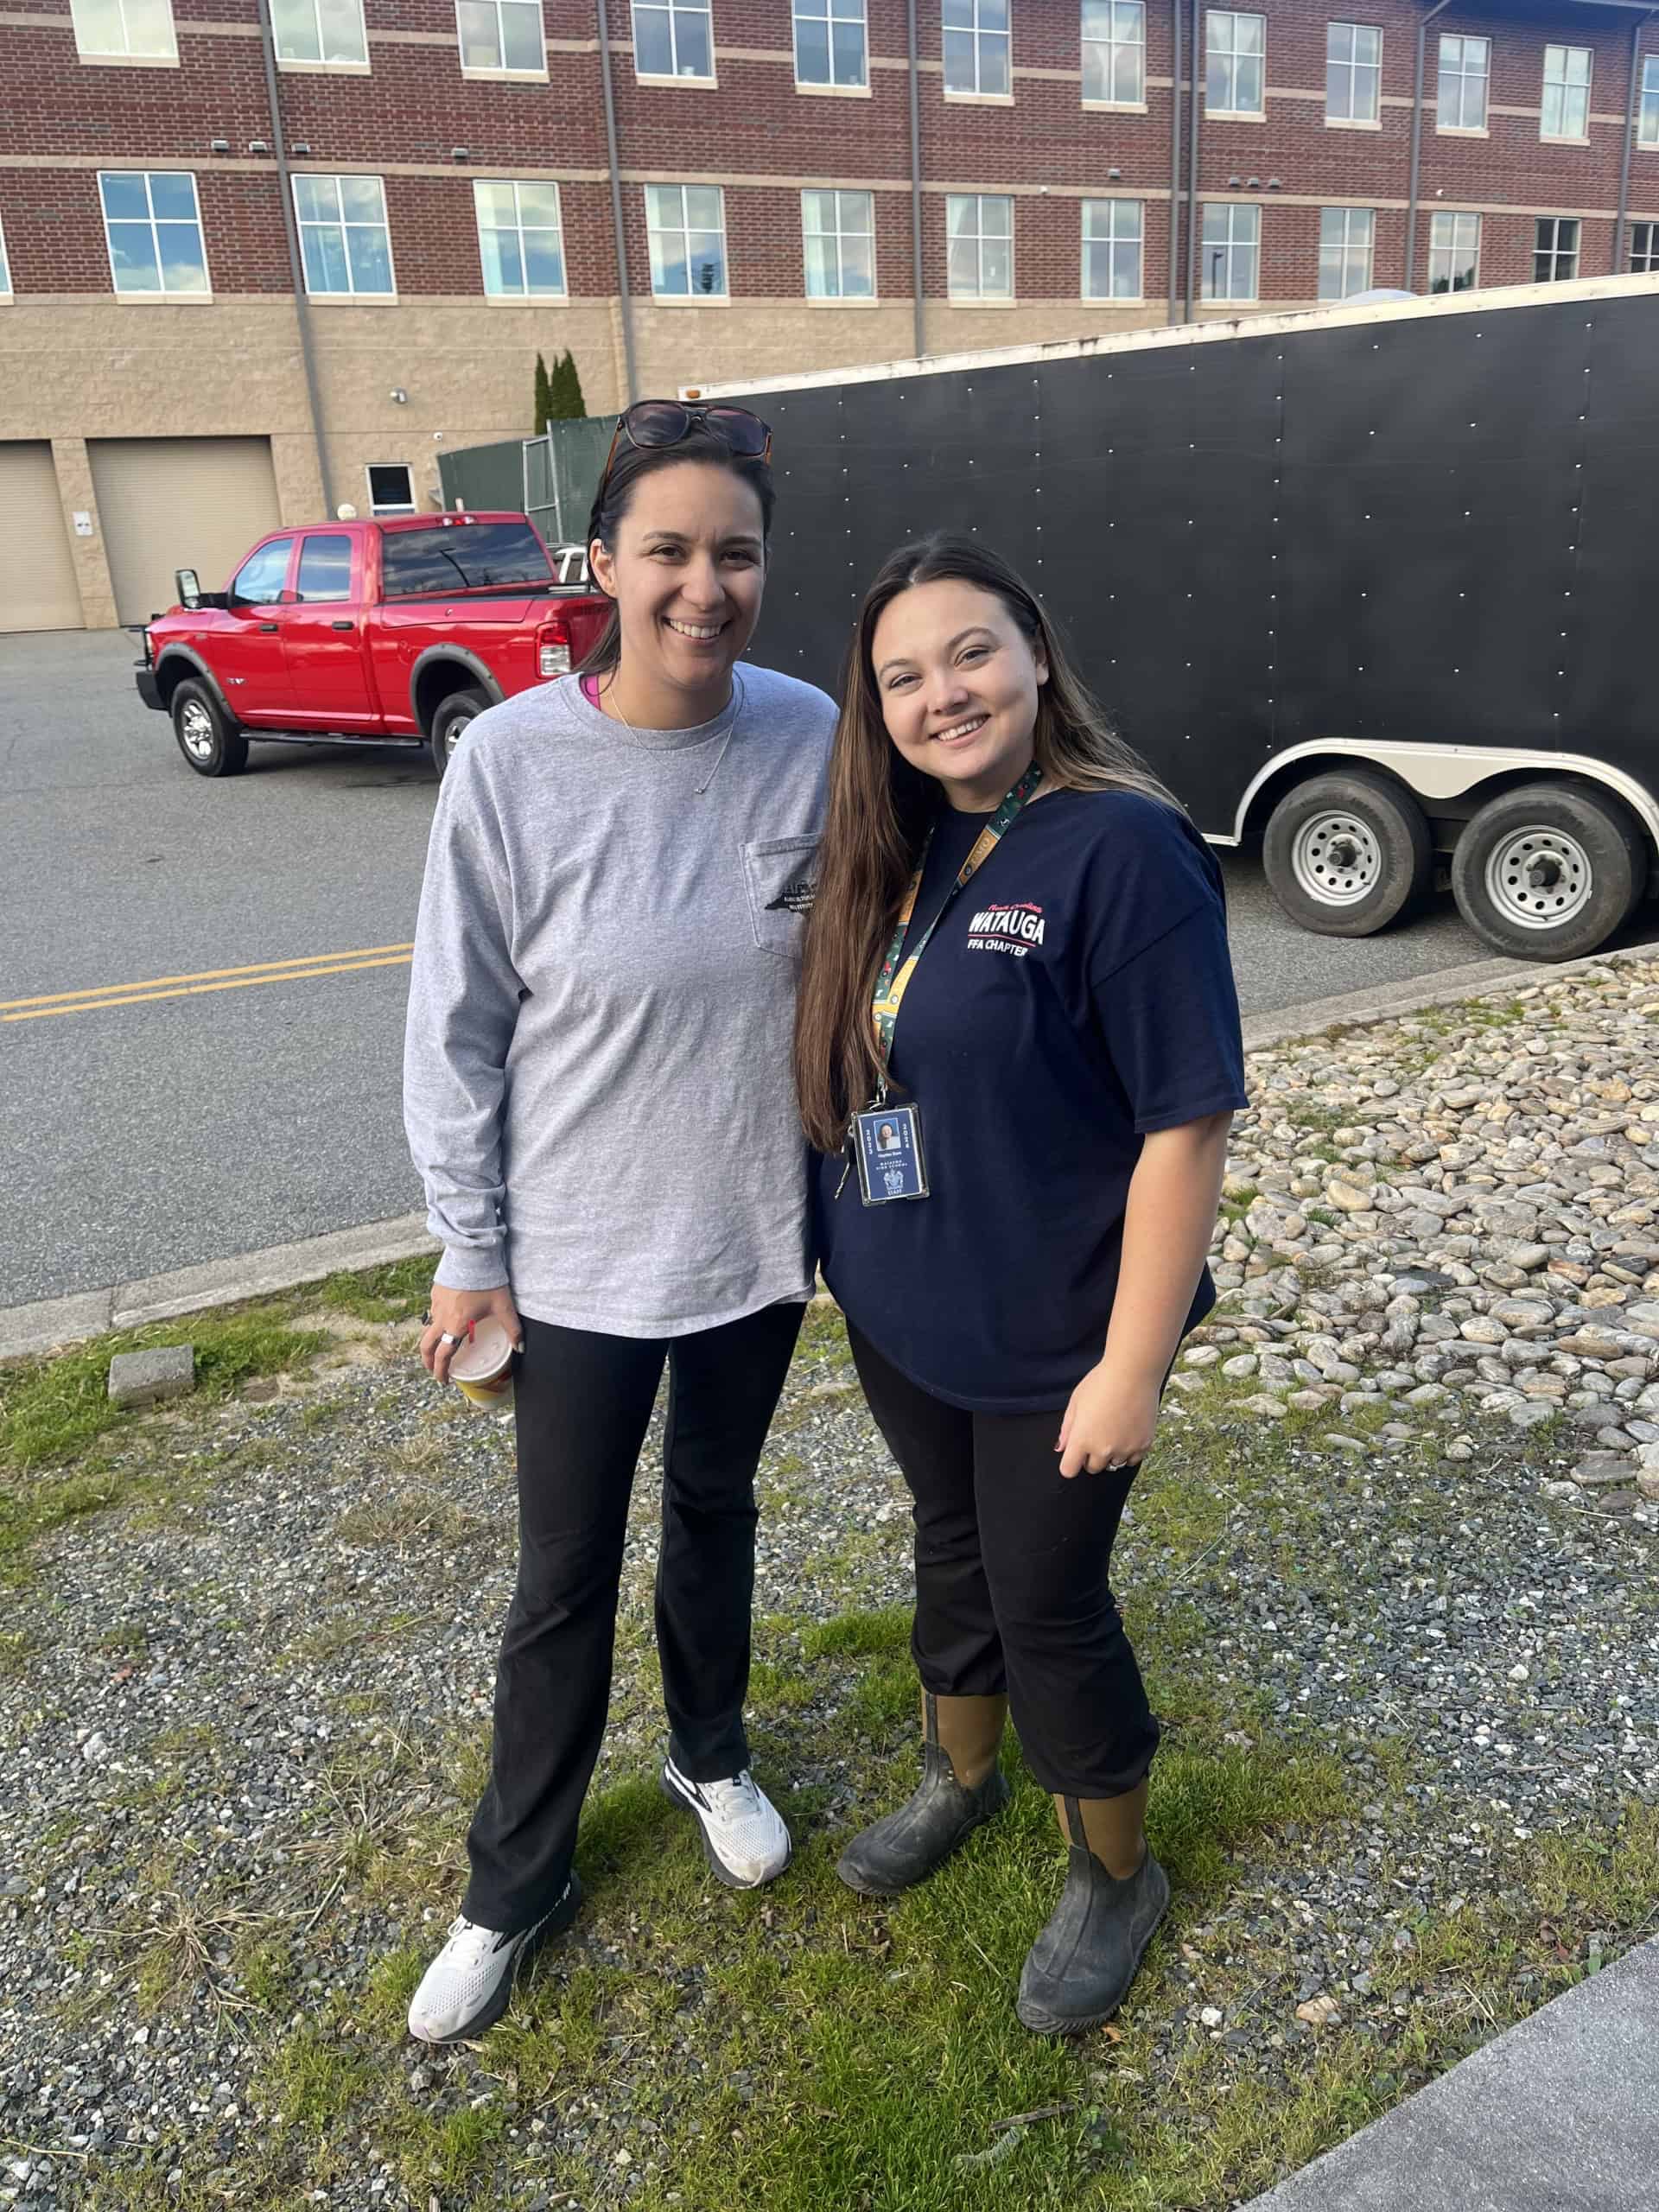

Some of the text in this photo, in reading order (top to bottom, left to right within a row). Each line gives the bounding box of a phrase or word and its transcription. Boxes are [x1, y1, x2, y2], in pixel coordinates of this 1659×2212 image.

[968, 910, 1046, 945] WATAUGA
[967, 938, 1028, 957] FFA CHAPTER
